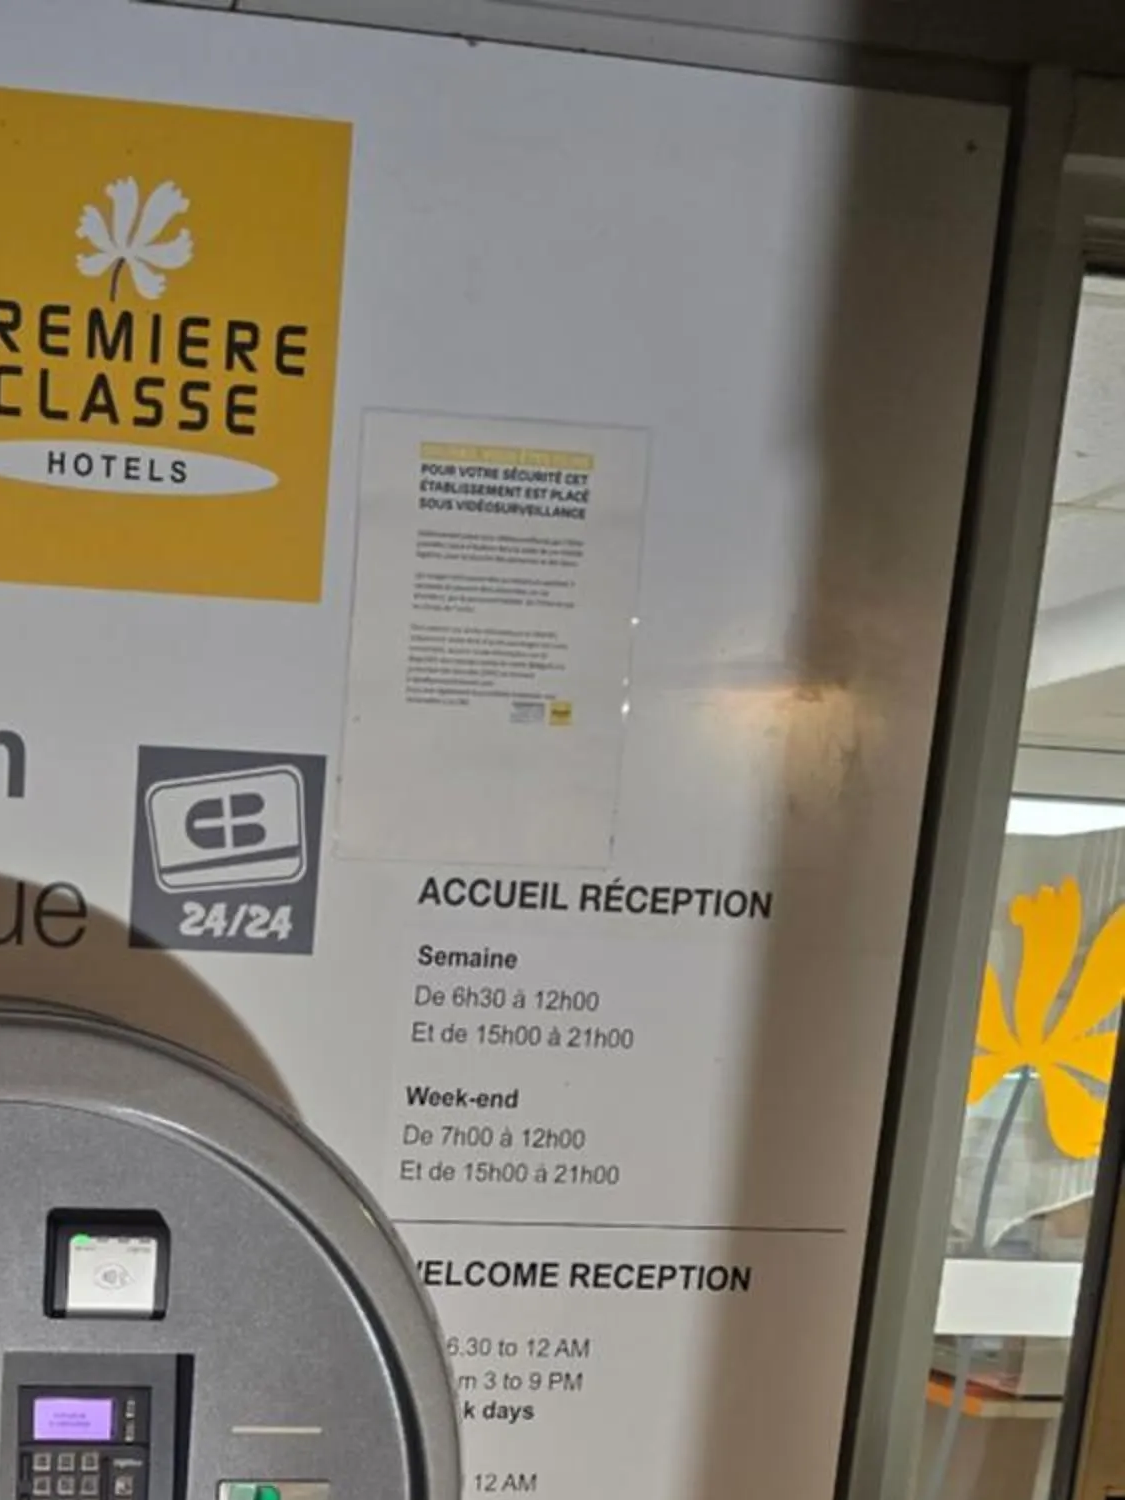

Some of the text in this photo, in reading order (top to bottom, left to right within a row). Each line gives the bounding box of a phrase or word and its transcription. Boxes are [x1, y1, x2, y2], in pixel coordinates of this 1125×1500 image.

[48, 451, 188, 483] HOTELS
[420, 463, 457, 478] POUR
[459, 465, 499, 481] VOTRE
[502, 466, 562, 485] SÉCURITÉ
[420, 478, 590, 504] ÉTABLISSEMENT EST PLACÉ
[419, 497, 586, 520] SOUS VIDÉOSURVEILLANCE
[418, 877, 772, 919] ACCUEIL RÉCEPTION
[180, 901, 293, 941] 24/24
[417, 945, 518, 970] Semaine
[414, 985, 599, 1012] De 6h30 à 12h00
[412, 1022, 634, 1049] Et de 15h00 à 21h00
[406, 1086, 519, 1109] Week-end
[403, 1125, 585, 1150] De 7h00 à 12h00
[400, 1160, 620, 1185] Et de 15h00 à 21h00
[417, 1260, 752, 1292] ELCOME RECEPTION
[498, 1340, 517, 1358] to
[527, 1339, 551, 1358] 12
[555, 1339, 590, 1359] AM
[483, 1371, 497, 1391] 3
[503, 1373, 523, 1391] to
[529, 1372, 542, 1391] 9
[548, 1373, 583, 1391] PM
[482, 1401, 534, 1424] days
[475, 1473, 537, 1492] 12 AM
